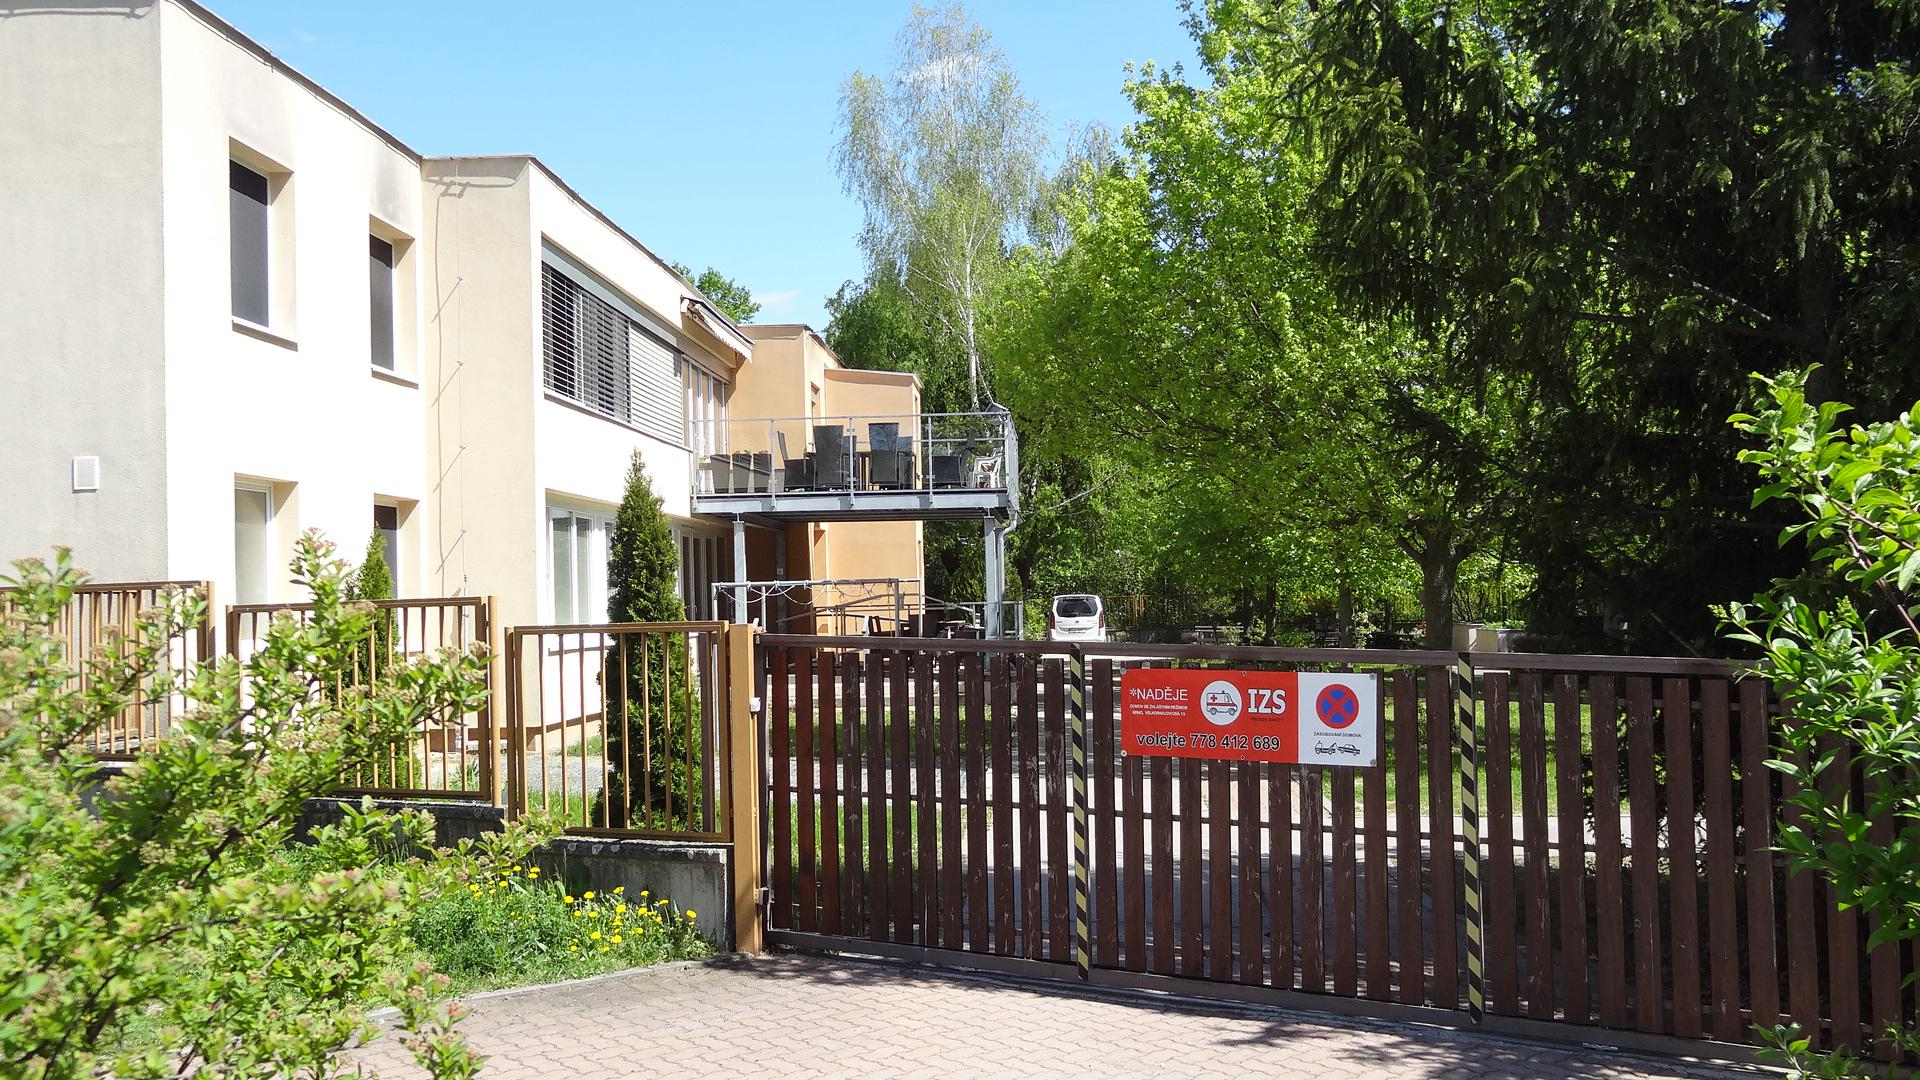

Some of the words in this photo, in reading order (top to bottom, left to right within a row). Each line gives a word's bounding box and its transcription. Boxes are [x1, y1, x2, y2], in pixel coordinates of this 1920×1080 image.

[1136, 686, 1188, 701] NADĚJE
[1247, 688, 1286, 715] IZS
[1136, 732, 1186, 750] volejte
[1190, 733, 1216, 749] 778
[1221, 735, 1248, 750] 412
[1252, 736, 1280, 751] 689
